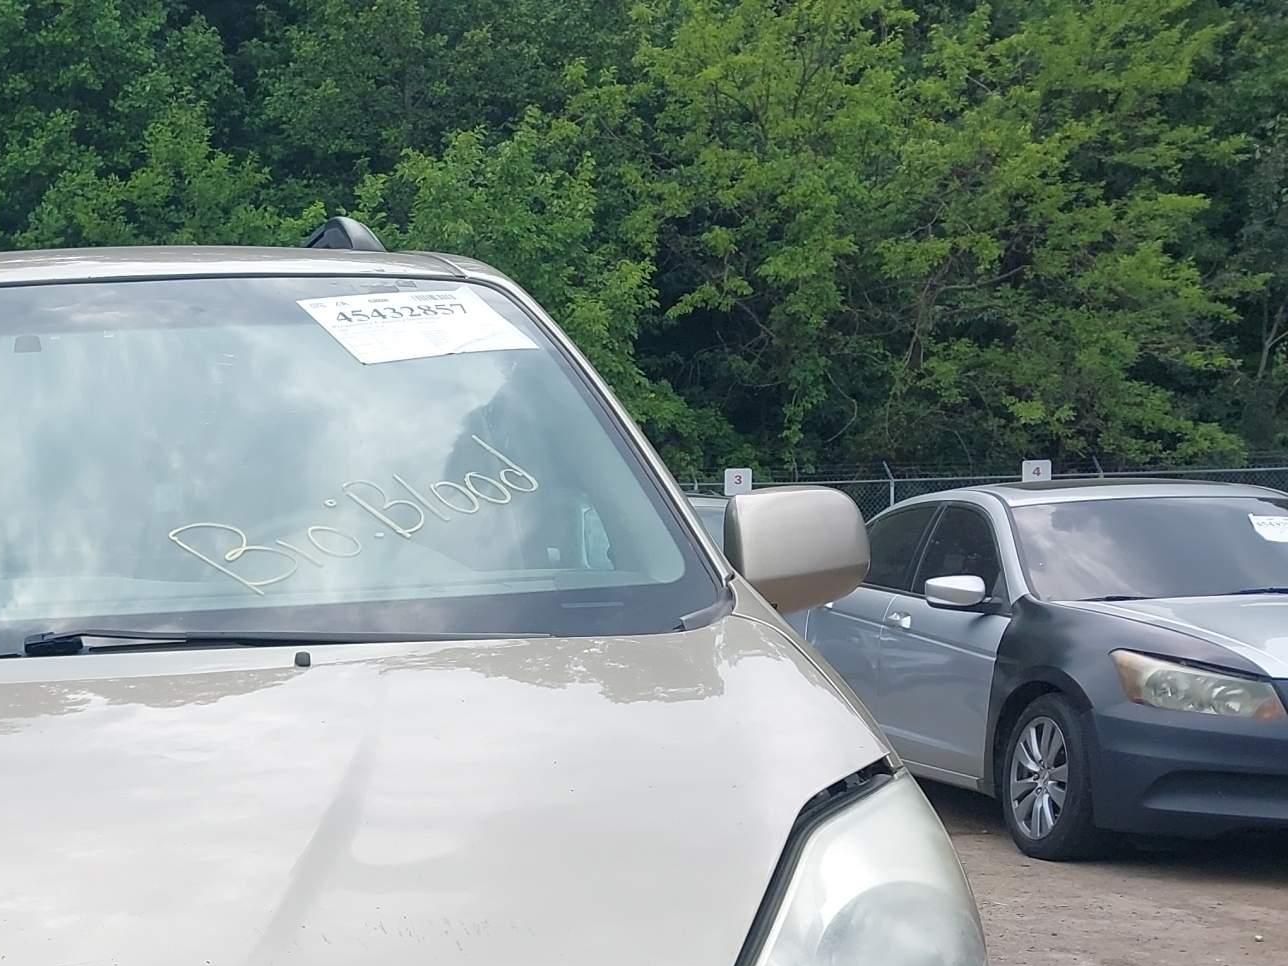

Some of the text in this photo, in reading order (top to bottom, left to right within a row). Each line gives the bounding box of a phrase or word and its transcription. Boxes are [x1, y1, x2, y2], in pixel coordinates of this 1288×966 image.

[336, 303, 468, 323] 45432857
[1032, 466, 1042, 477] 4
[734, 474, 743, 485] 3
